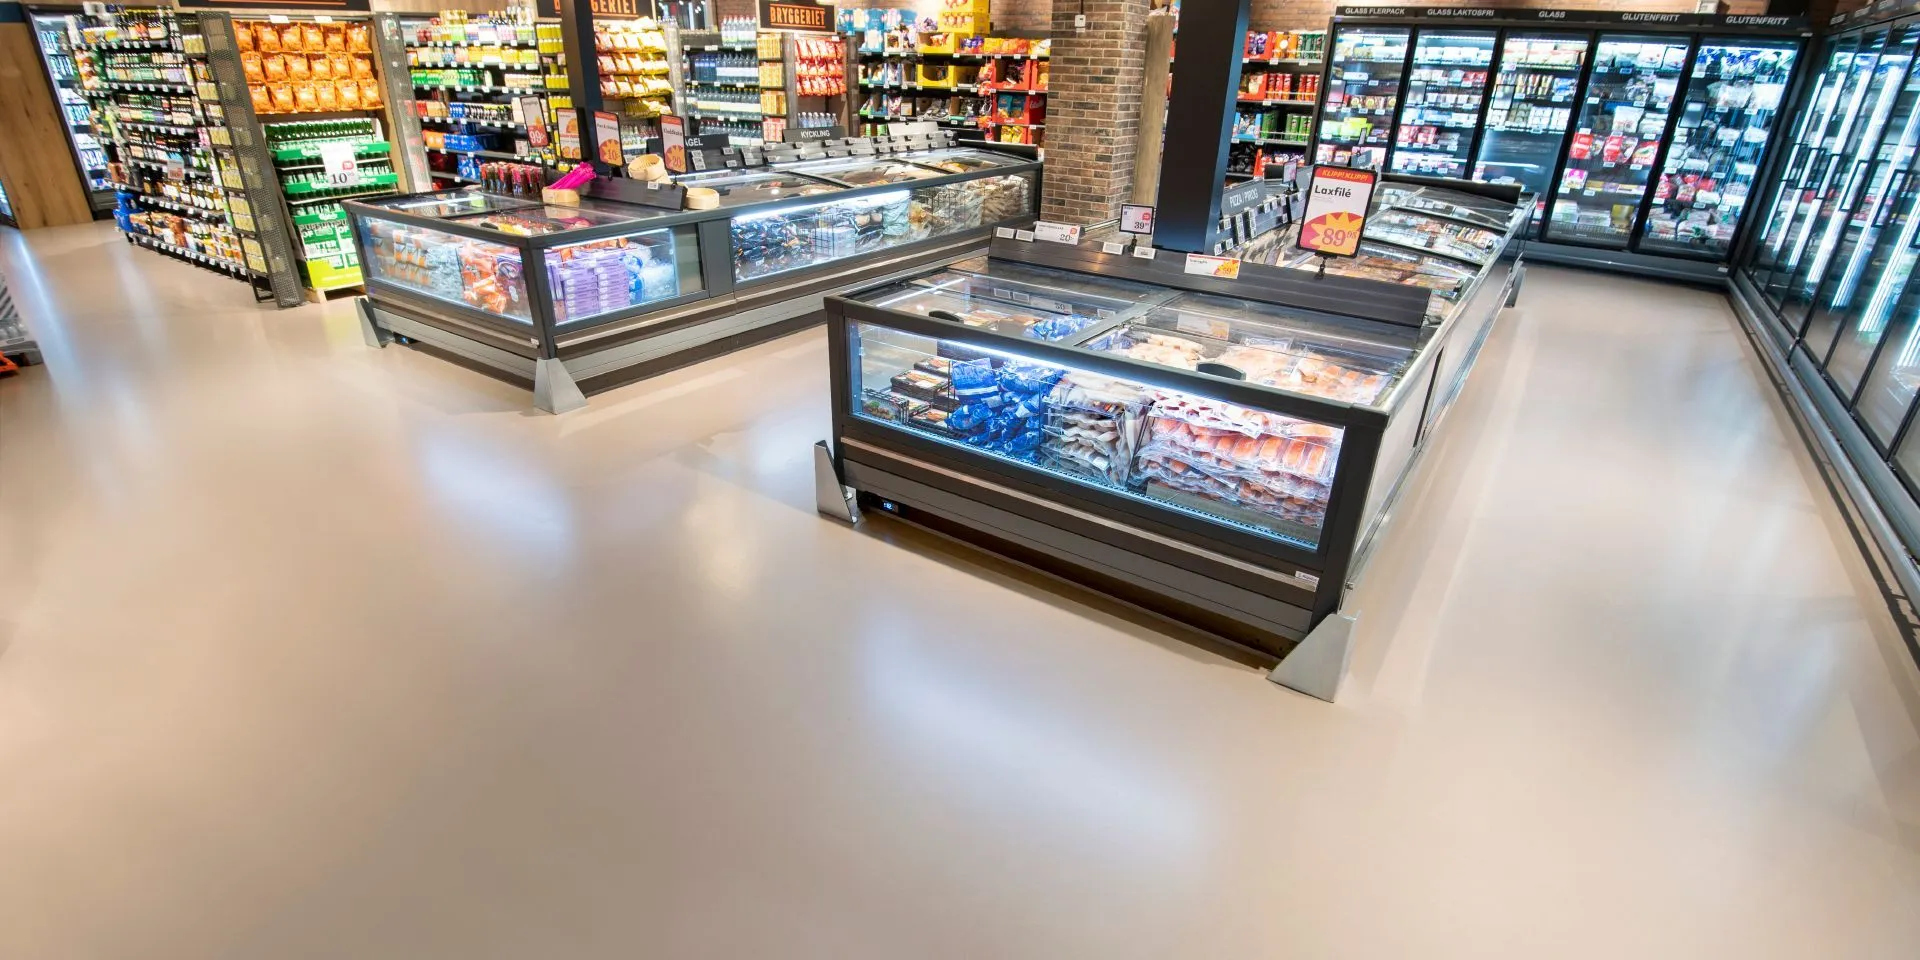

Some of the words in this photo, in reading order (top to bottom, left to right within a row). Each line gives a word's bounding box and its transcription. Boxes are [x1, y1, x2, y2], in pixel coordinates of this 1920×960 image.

[770, 6, 825, 26] BRYGGERIET
[1345, 7, 1368, 15] GLASS
[1369, 8, 1405, 16] FLERPACK
[1427, 8, 1452, 16] GLASS
[1453, 9, 1494, 17] LAKTOSFRI
[1538, 10, 1565, 19] GLASS
[1622, 13, 1680, 22] GLUTENFRITT
[1726, 15, 1789, 26] GLUTENFRITT
[800, 129, 830, 138] KYCKLING
[1322, 169, 1345, 178] KLIPP!
[1345, 171, 1369, 182] KLIPP!
[1314, 184, 1352, 198] Laxfilé
[1229, 193, 1243, 209] PIZZA
[1244, 187, 1259, 203] PIROG
[1322, 227, 1346, 247] 89
